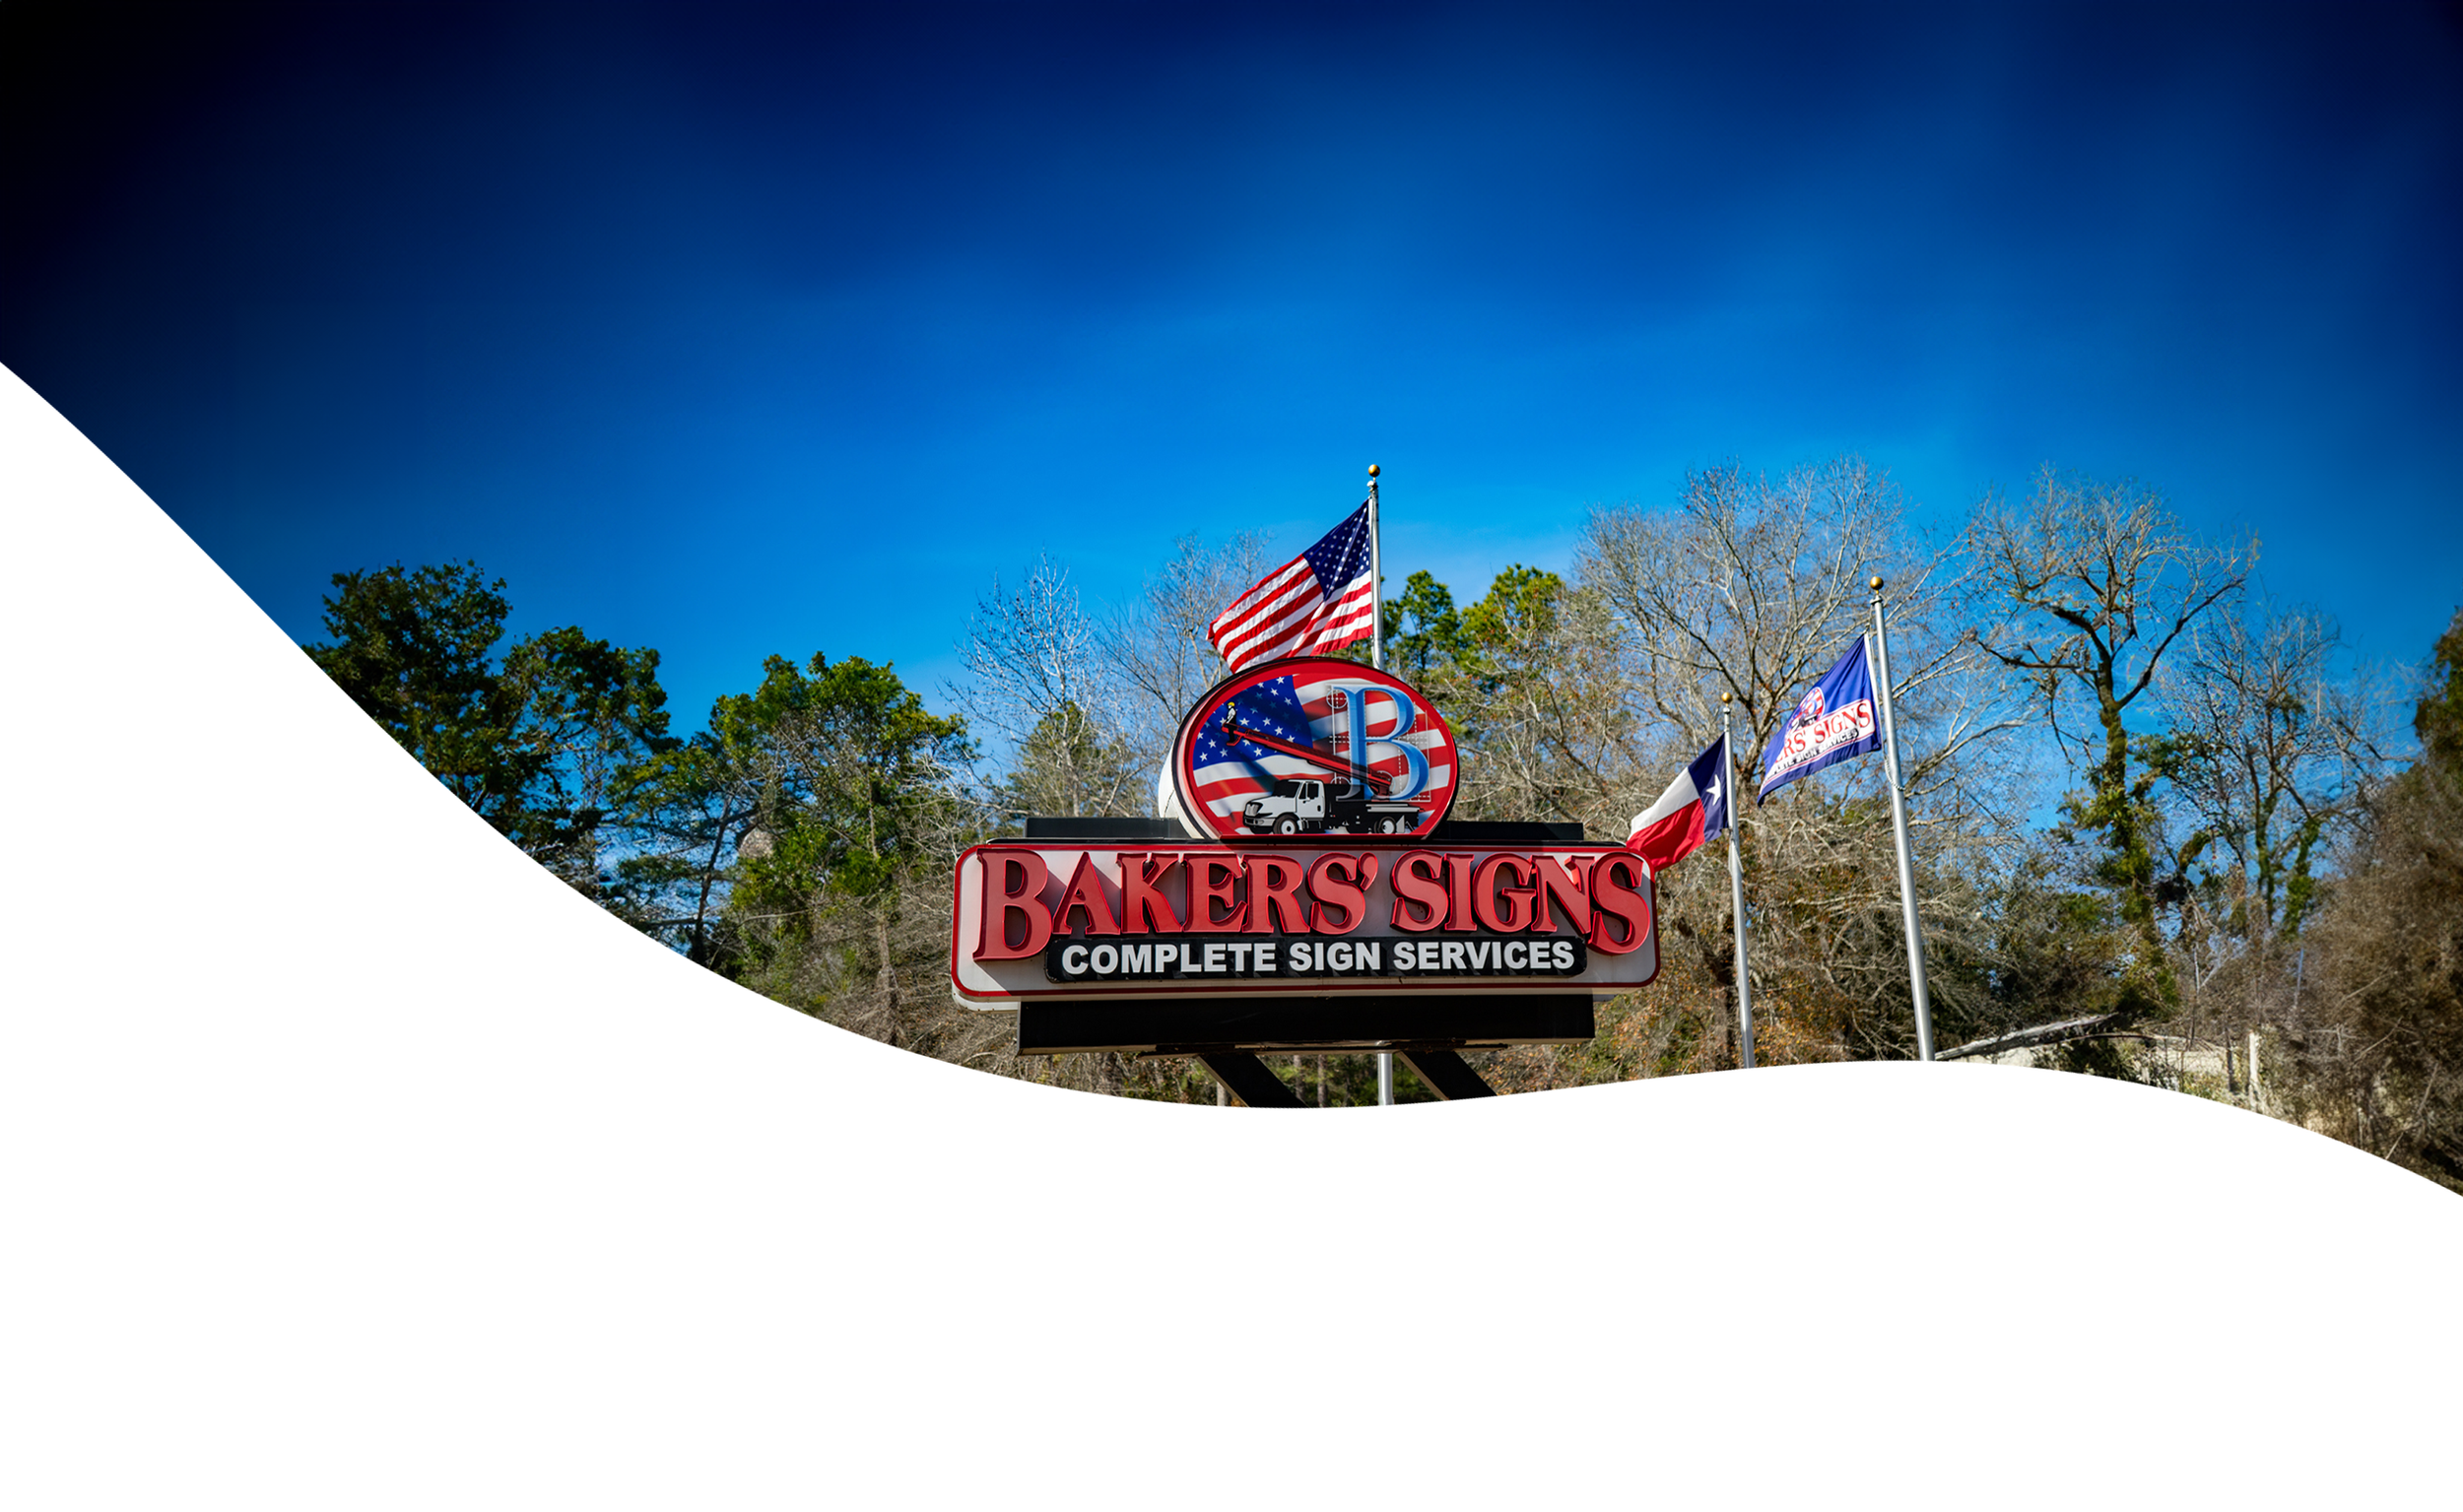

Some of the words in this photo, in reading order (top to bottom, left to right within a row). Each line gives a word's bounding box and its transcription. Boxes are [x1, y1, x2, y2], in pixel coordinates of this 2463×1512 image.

[1326, 684, 1430, 801] B
[1814, 702, 1871, 744] SIGNS
[972, 848, 1378, 960] BAKERS'
[1390, 849, 1651, 955] SIGNS
[1061, 943, 1277, 975] COMPLETE
[1289, 942, 1380, 971] SIGN
[1393, 941, 1575, 971] SERVICES
